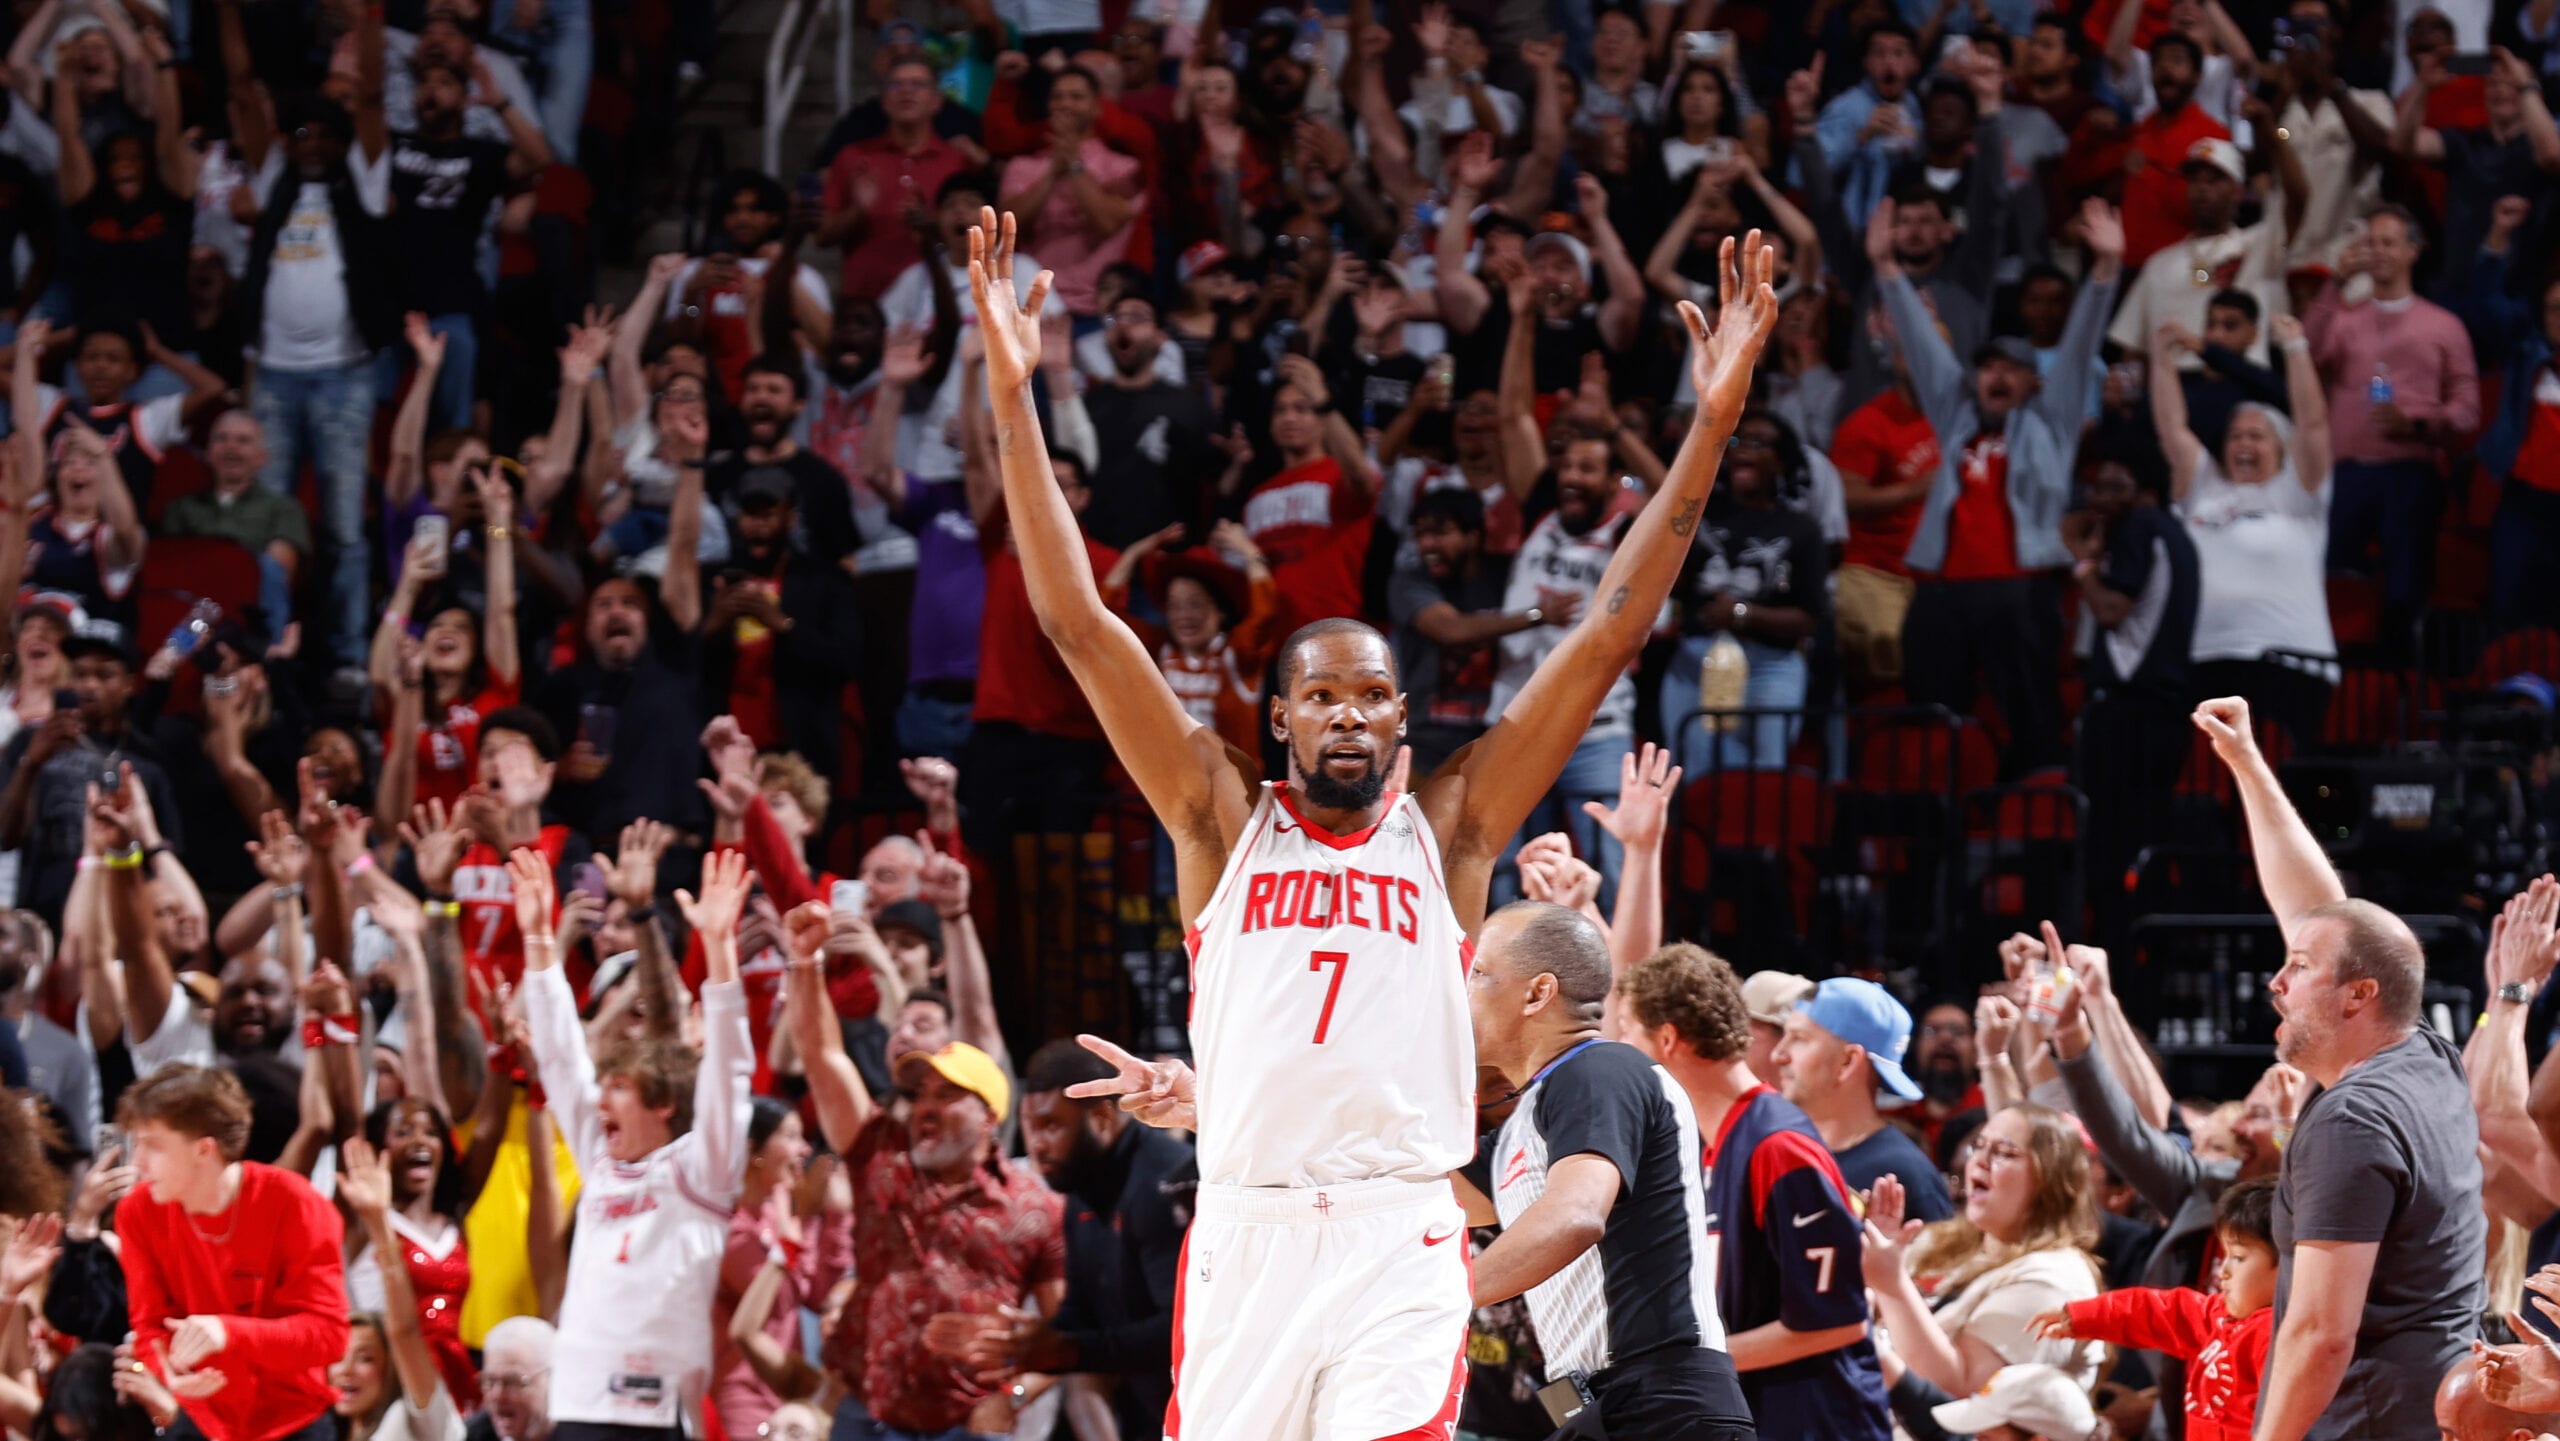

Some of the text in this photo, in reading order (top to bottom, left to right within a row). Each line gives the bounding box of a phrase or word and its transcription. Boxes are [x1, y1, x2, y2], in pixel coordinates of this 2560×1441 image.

[475, 906, 502, 957] 7
[1241, 867, 1420, 944] ROCKETS
[1310, 951, 1349, 1044] 7
[1805, 1246, 1835, 1293] 7
